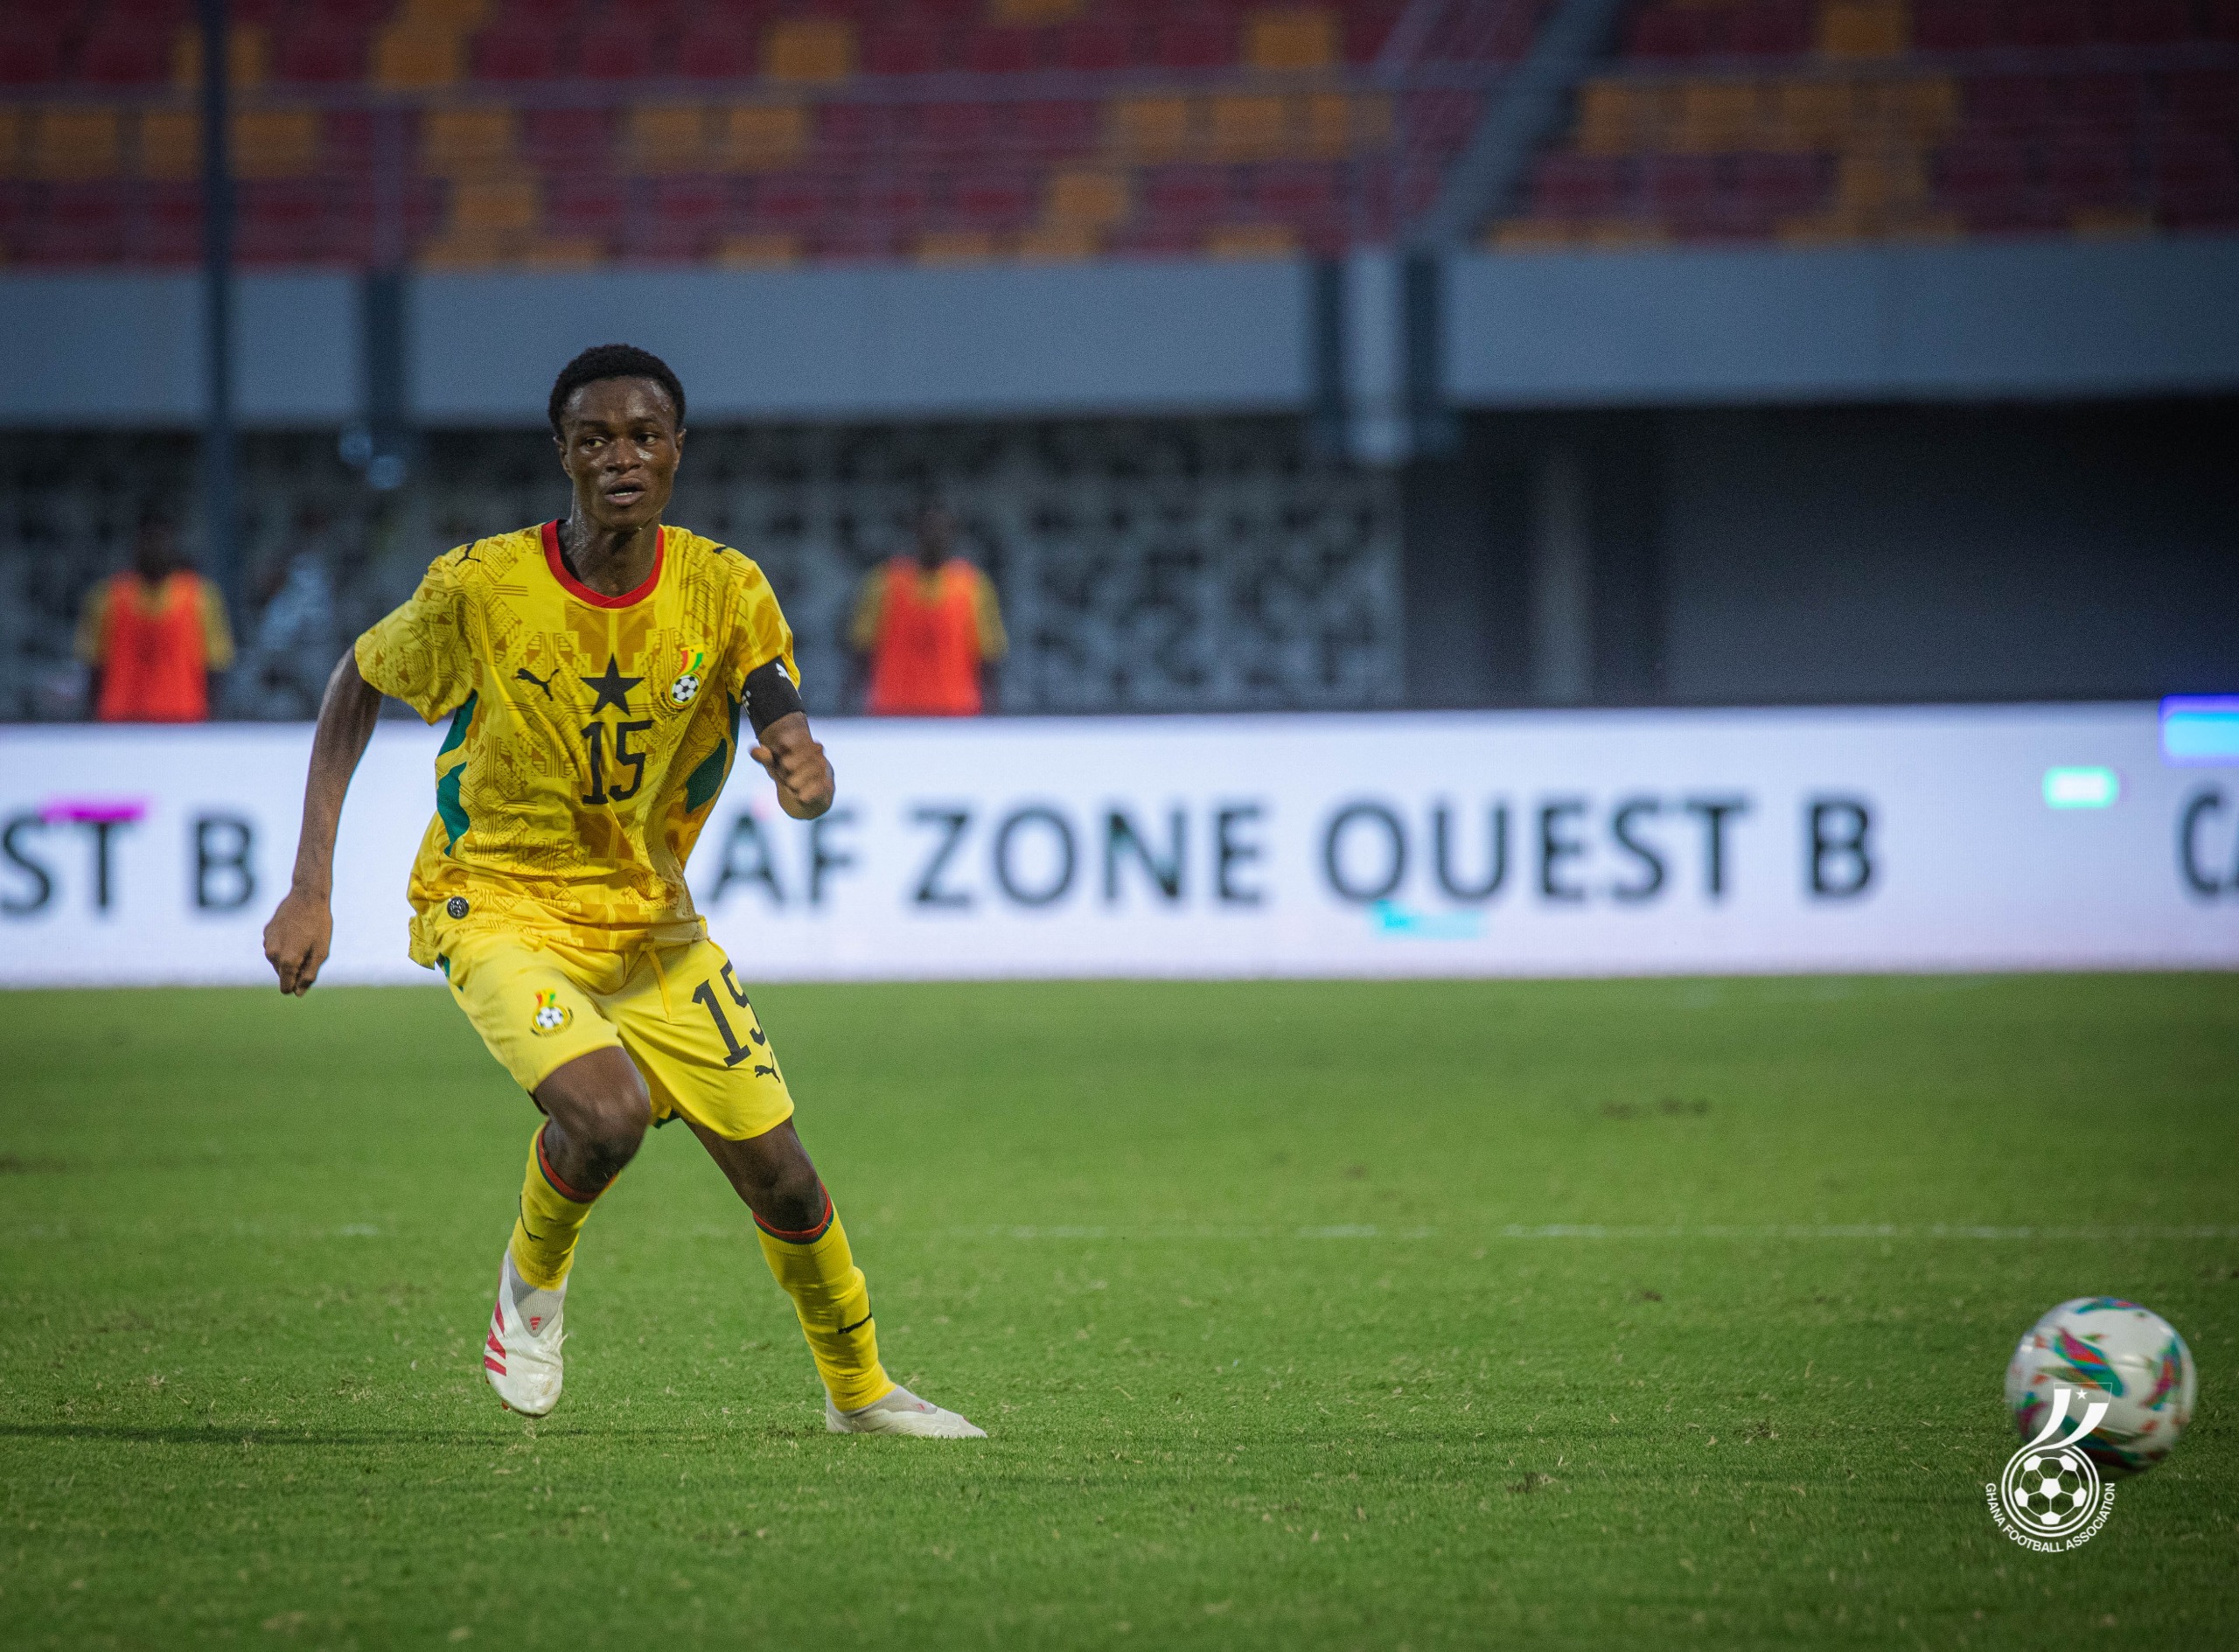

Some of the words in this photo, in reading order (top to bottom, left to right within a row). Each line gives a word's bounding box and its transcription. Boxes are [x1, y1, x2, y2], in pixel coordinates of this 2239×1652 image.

[579, 719, 653, 805] 15
[192, 808, 259, 914] B
[908, 799, 1266, 910] ZONE
[1319, 794, 1753, 911] QUEST
[1805, 791, 1879, 901] B
[2176, 789, 2239, 897] C
[691, 958, 766, 1068] 15
